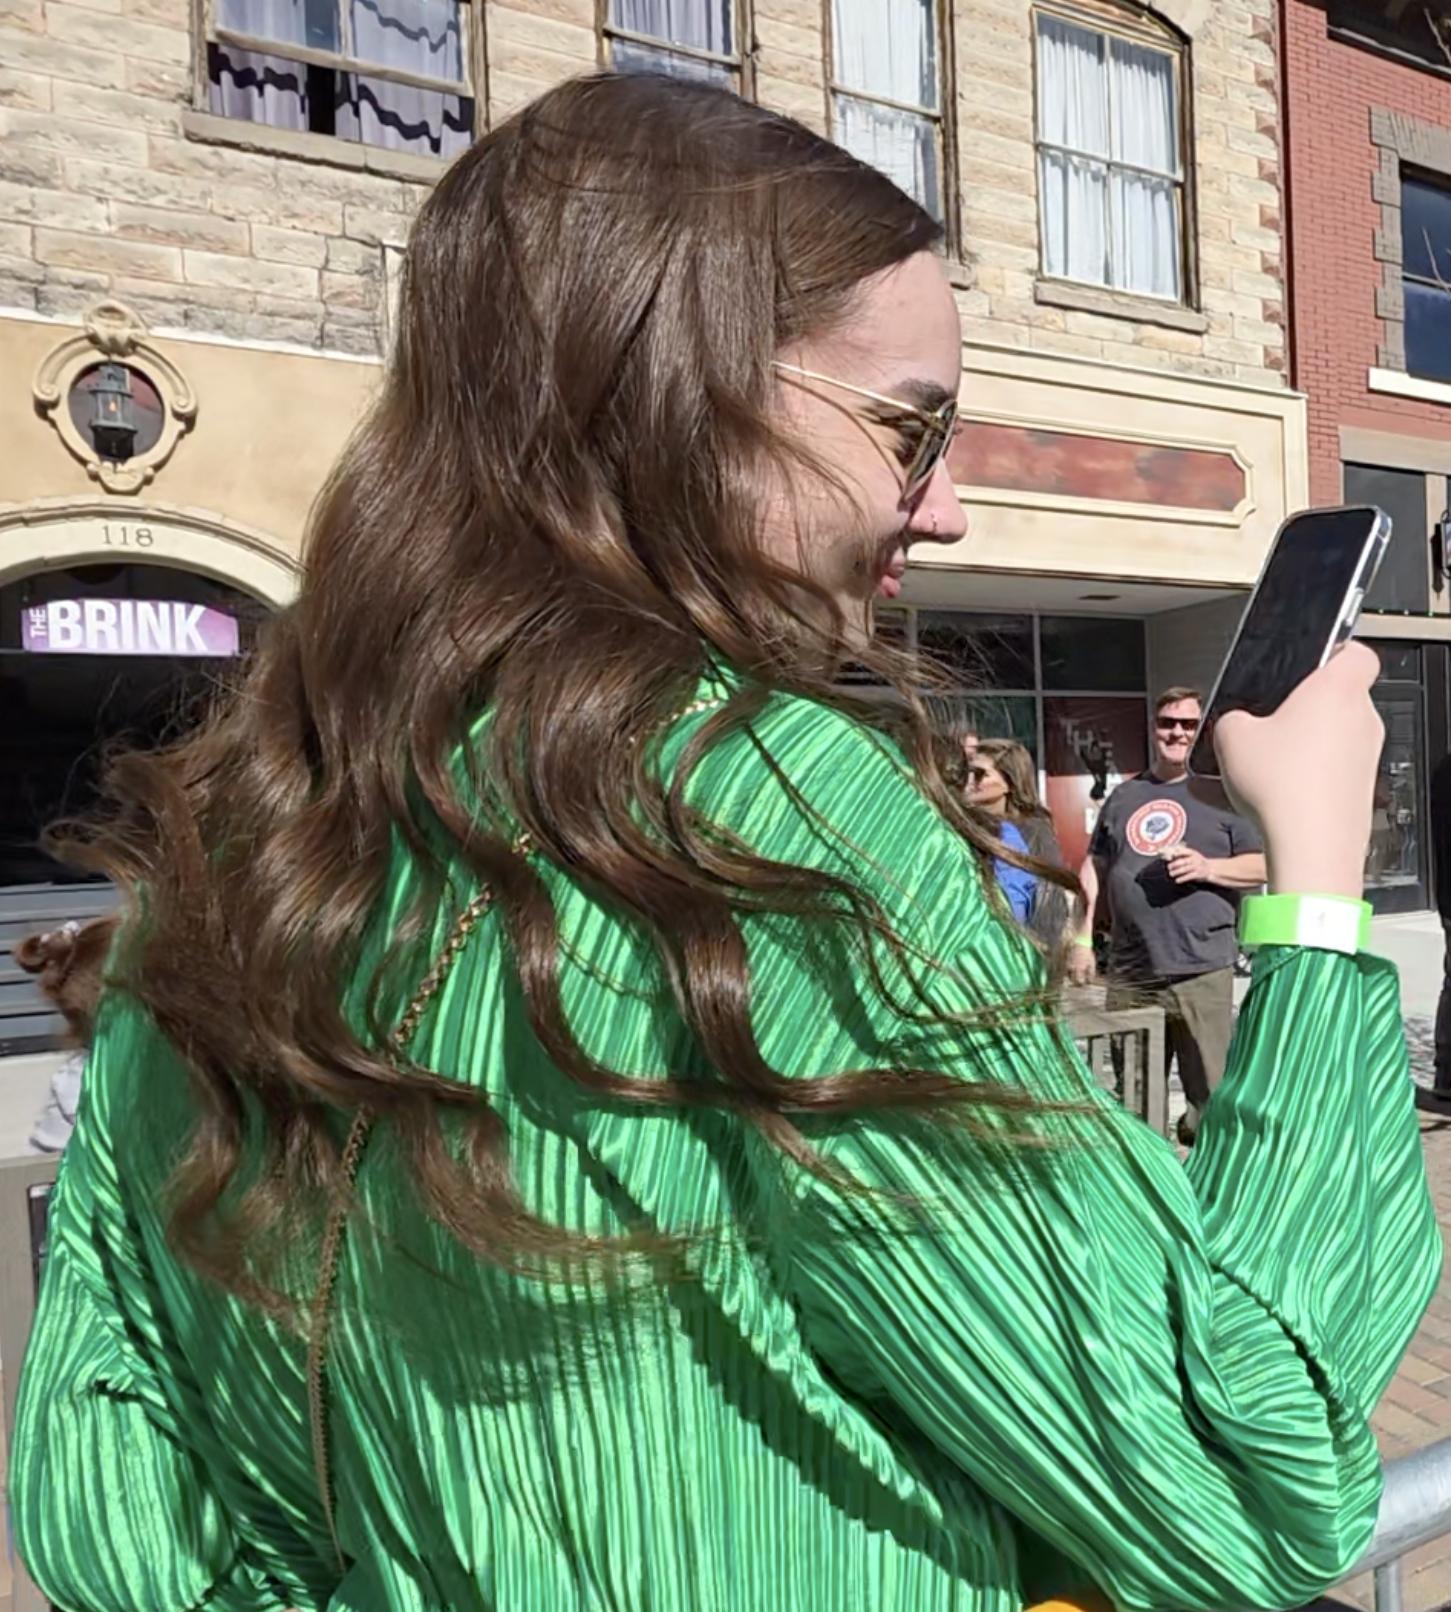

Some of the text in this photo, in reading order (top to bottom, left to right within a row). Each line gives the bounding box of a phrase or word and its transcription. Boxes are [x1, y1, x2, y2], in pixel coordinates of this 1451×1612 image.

[102, 524, 154, 547] 118
[29, 606, 47, 638] THE
[48, 599, 208, 651] BRINK
